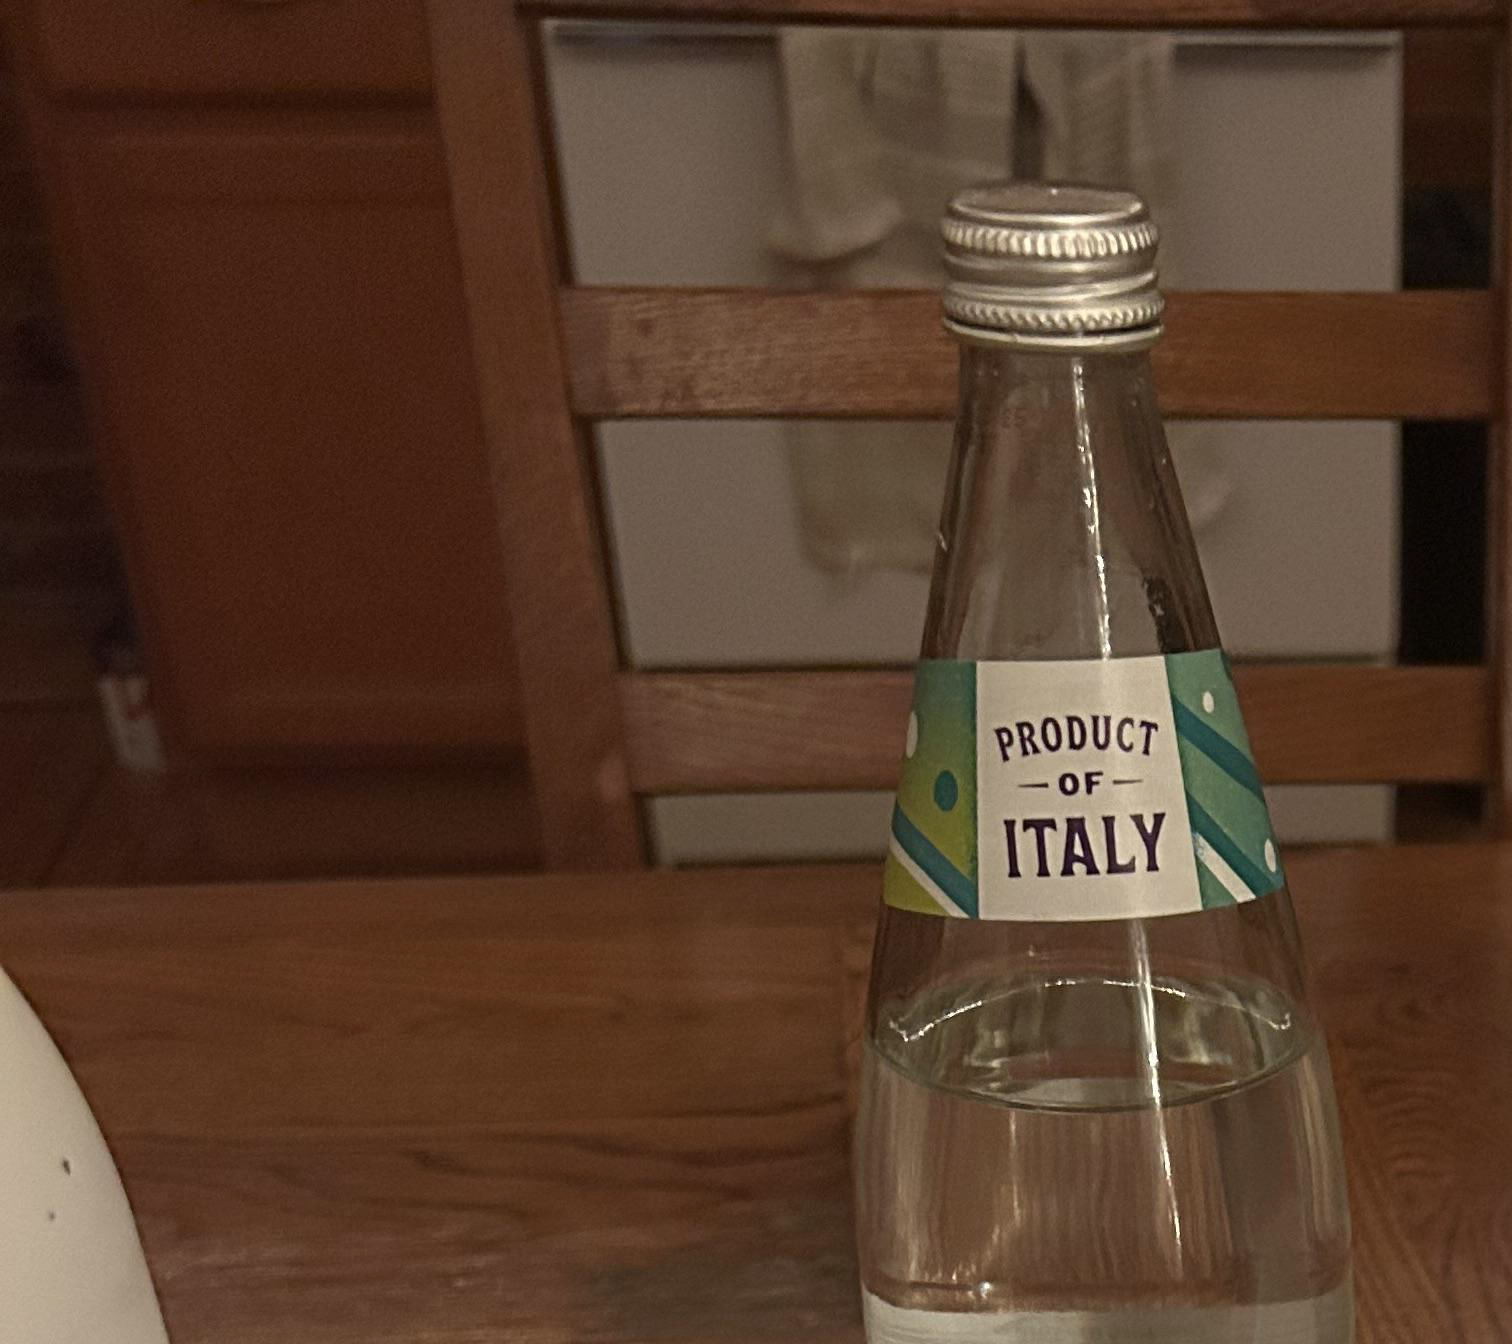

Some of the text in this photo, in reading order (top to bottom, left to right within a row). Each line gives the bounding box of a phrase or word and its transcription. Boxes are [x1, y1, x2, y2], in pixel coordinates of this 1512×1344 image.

[994, 715, 1159, 762] PRODUCT
[1058, 772, 1104, 797] OF
[1003, 812, 1166, 879] ITALY
